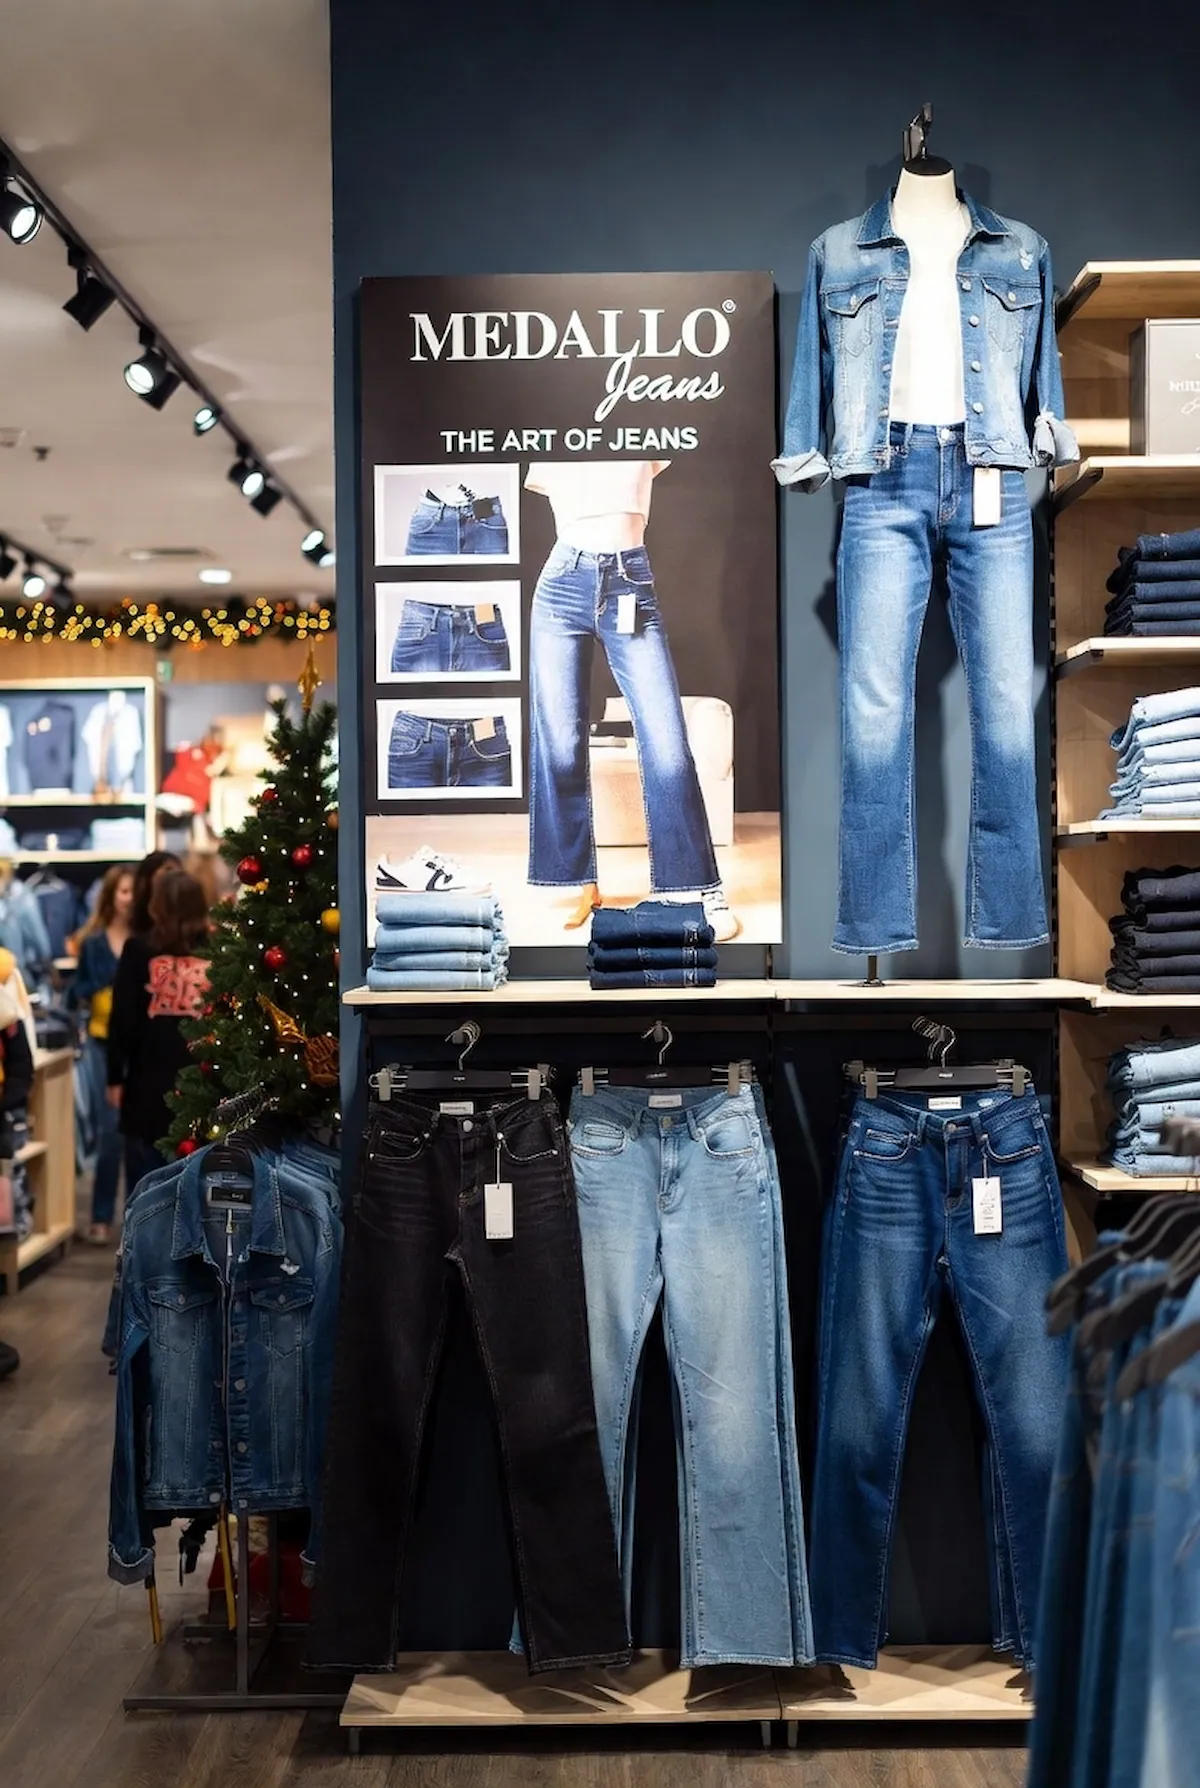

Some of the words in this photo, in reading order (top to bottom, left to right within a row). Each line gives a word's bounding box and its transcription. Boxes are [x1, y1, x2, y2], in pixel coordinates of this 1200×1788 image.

[410, 307, 731, 361] MEDALLO
[594, 340, 724, 422] Jeans
[440, 429, 494, 453] THE
[501, 428, 557, 452] ART
[564, 427, 602, 451] OF
[608, 426, 699, 451] JEANS
